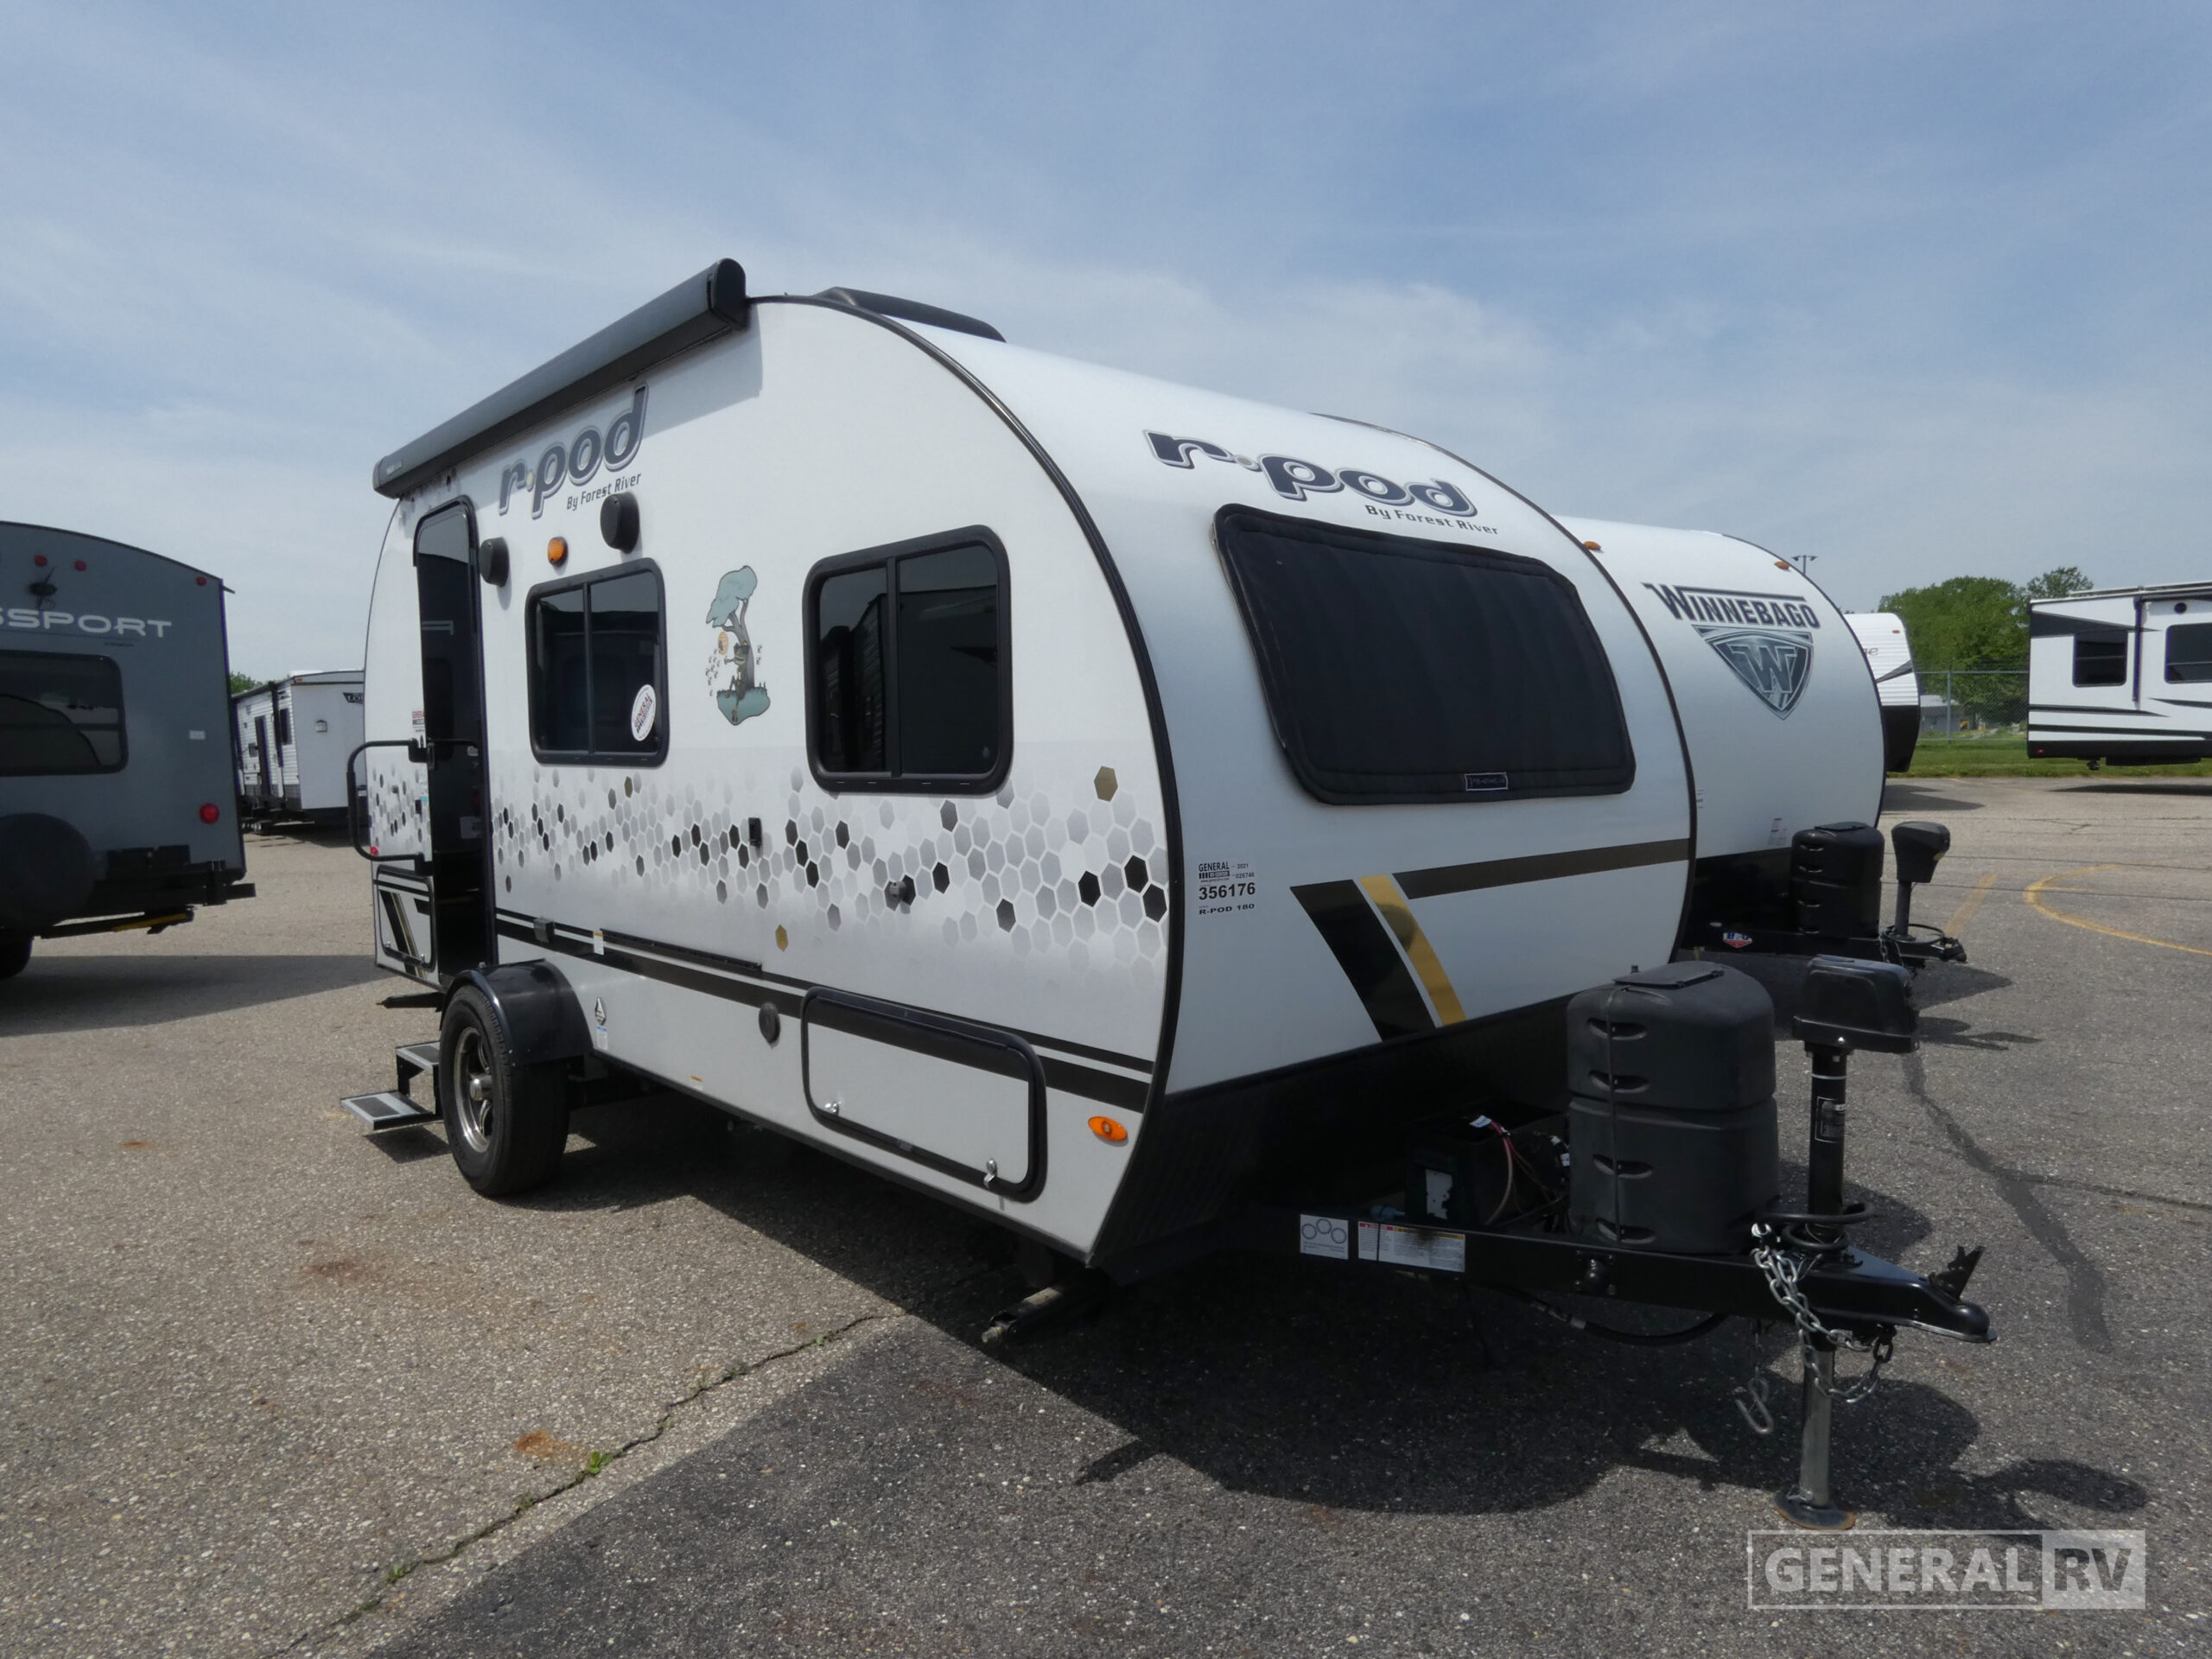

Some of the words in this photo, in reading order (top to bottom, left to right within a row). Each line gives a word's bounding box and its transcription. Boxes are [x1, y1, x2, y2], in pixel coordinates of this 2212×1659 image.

[567, 497, 578, 512] By
[581, 484, 612, 505] Forest
[614, 473, 641, 493] River
[1365, 505, 1391, 519] By
[1395, 509, 1454, 527] Forest
[1456, 520, 1498, 535] River
[1641, 582, 1821, 629] WINNEBAGO
[0, 607, 172, 638] SPORT
[1198, 861, 1230, 872] GENERAL
[1198, 882, 1255, 900] 356176
[1198, 906, 1232, 915] R-POD
